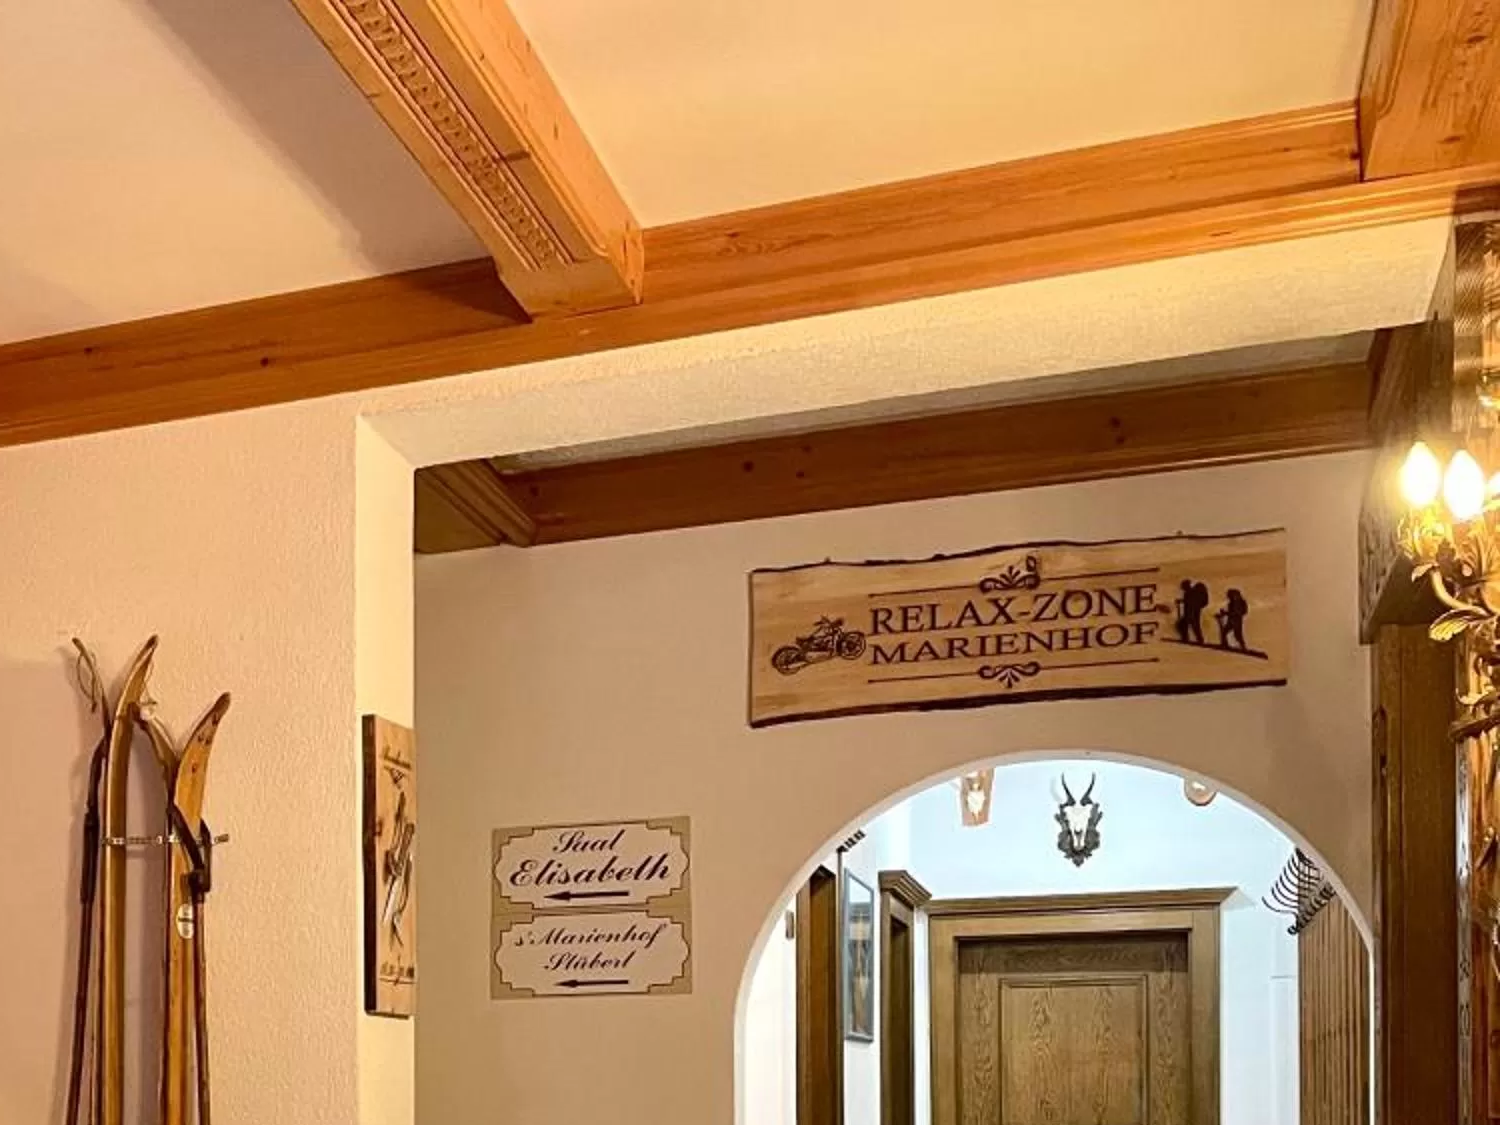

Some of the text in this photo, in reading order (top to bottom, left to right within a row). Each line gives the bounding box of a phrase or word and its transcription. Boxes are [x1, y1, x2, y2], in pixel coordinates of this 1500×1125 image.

[869, 584, 1158, 636] RELAX-ZONE
[870, 621, 1160, 665] MARIENHOF
[552, 829, 626, 854] Saal
[509, 852, 670, 887] Elisabeth
[542, 949, 637, 971] Stüberl
